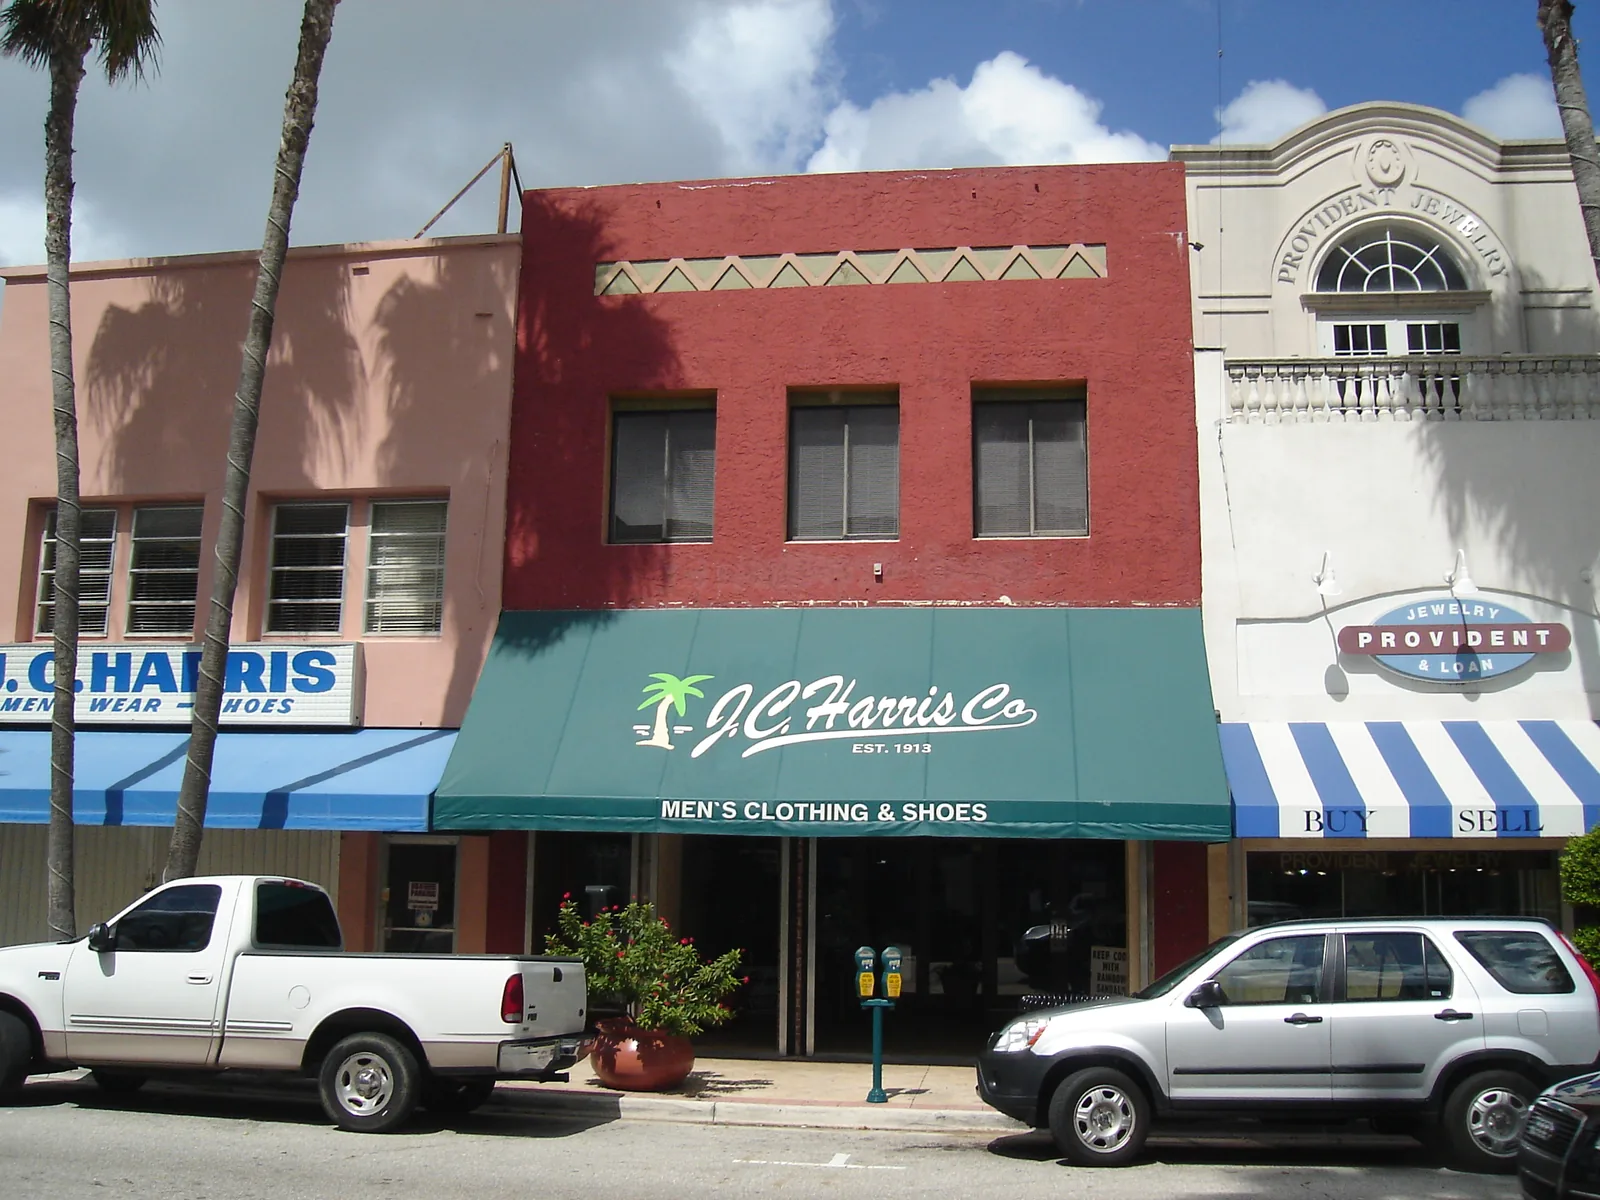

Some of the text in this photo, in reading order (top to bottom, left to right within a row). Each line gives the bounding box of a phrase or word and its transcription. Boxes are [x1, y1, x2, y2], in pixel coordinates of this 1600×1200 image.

[1277, 187, 1509, 285] PROVIDENT JEWELRY
[1407, 604, 1500, 621] JEWELRY
[1358, 630, 1549, 648] PROVIDENT
[1418, 659, 1494, 673] & LOAN
[90, 698, 162, 713] WEAR
[222, 698, 295, 713] HOES
[852, 743, 932, 754] EST. 1913
[661, 801, 988, 822] MEN'S CLOTHING & SHOES
[1303, 810, 1377, 832] BUY
[1458, 810, 1544, 832] SELL
[1113, 952, 1126, 961] COO
